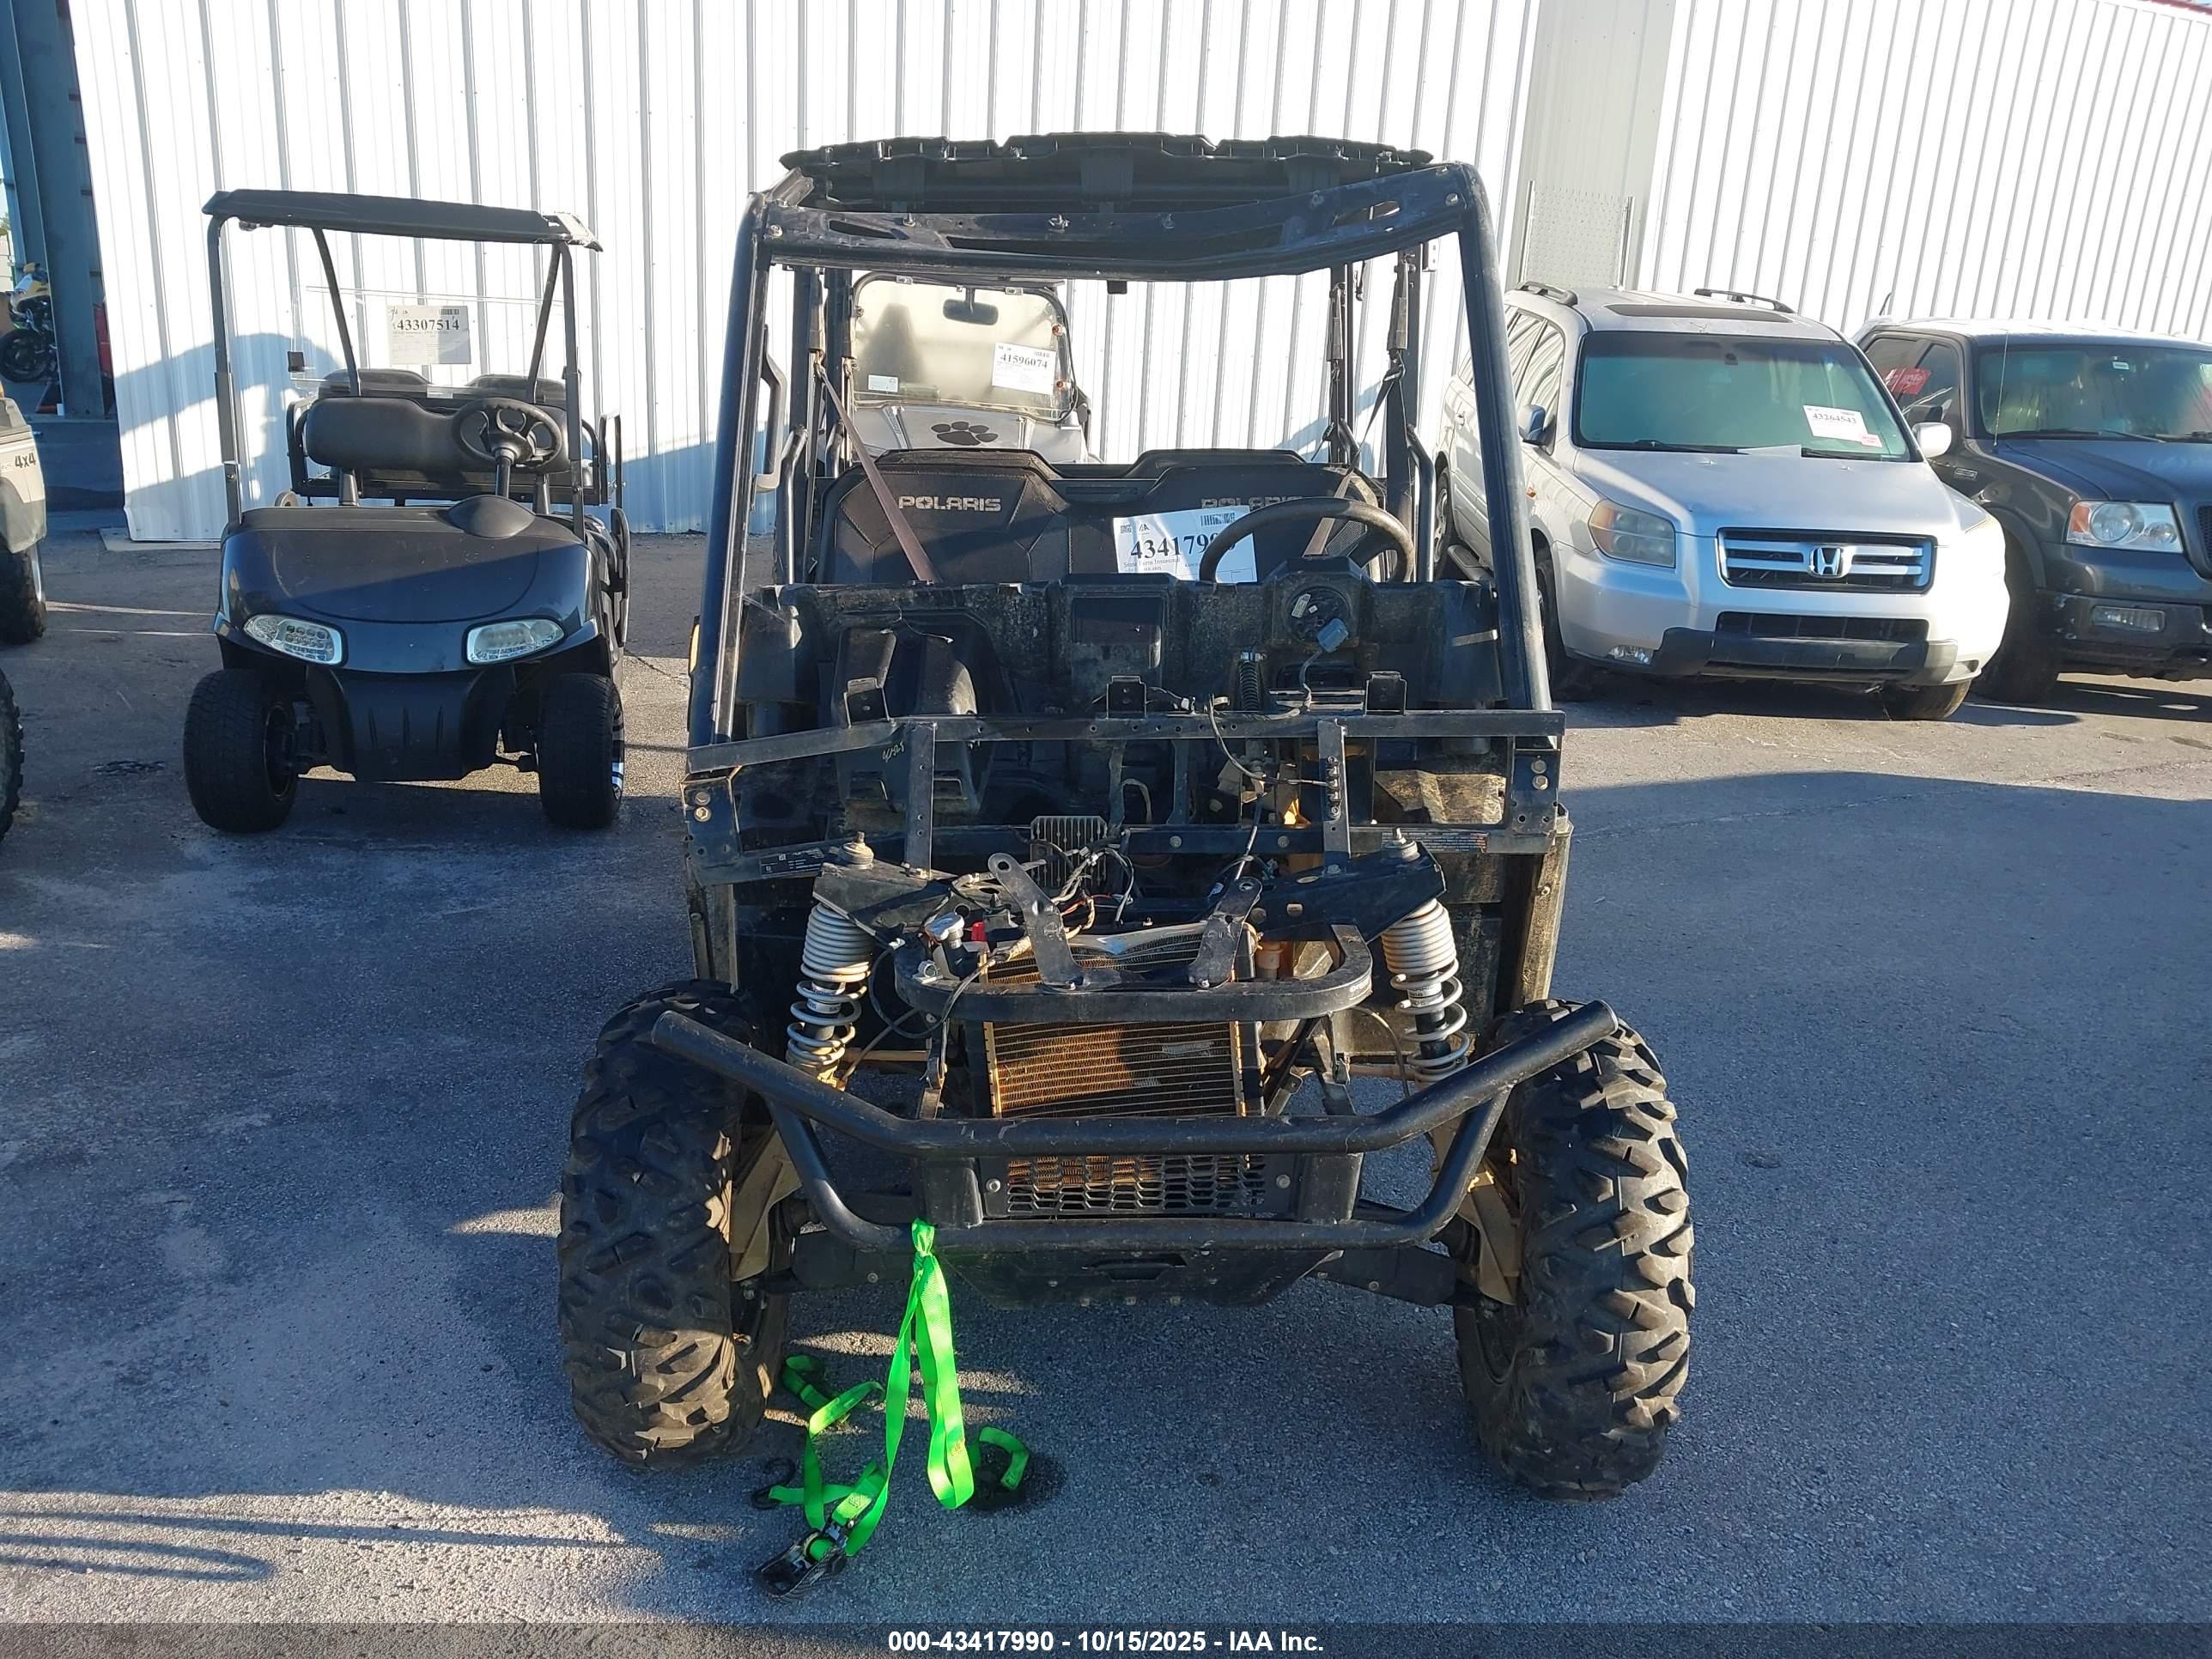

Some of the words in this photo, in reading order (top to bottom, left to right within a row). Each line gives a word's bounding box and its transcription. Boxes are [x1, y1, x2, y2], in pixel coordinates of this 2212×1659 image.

[397, 319, 459, 331] 43307514
[1000, 353, 1048, 369] 41596074
[898, 496, 1001, 511] POLARIS
